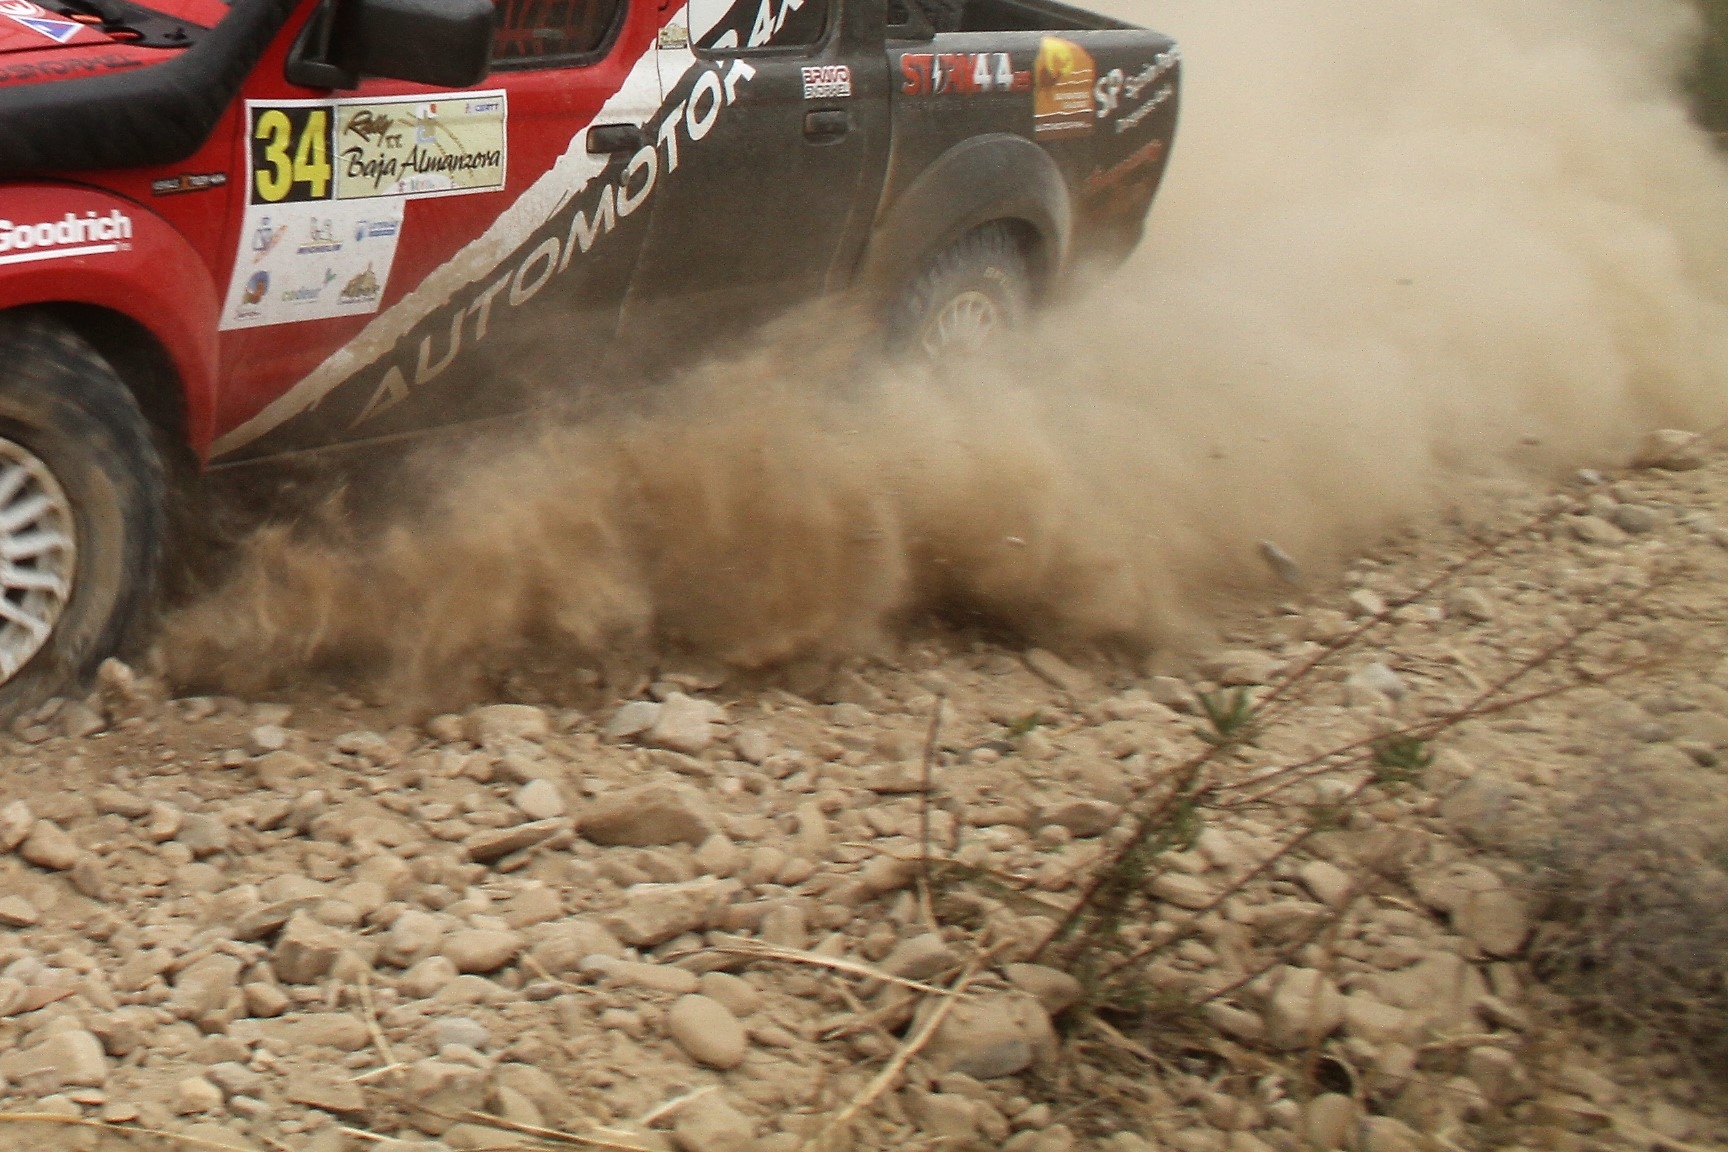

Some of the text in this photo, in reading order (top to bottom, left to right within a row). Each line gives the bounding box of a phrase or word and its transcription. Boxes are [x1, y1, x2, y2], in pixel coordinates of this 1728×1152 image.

[254, 109, 332, 203] 34
[340, 145, 398, 190] Baja
[396, 144, 501, 183] Almanzora
